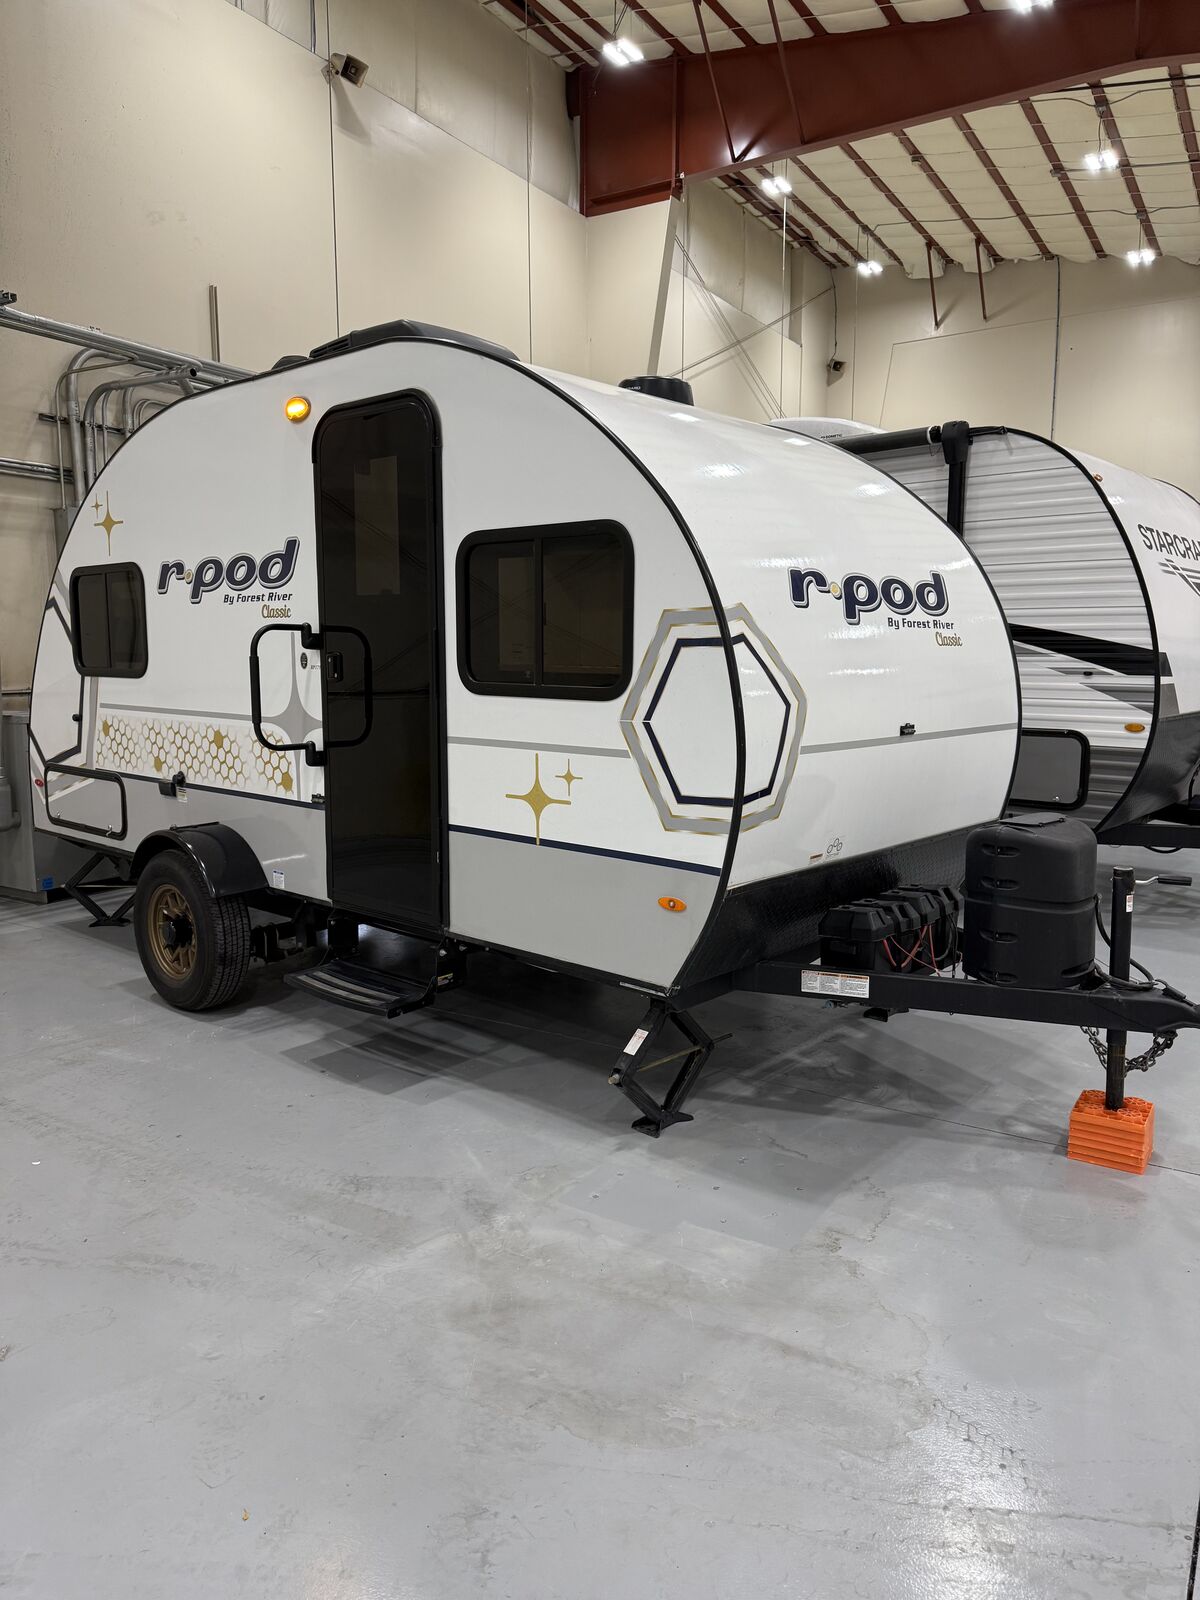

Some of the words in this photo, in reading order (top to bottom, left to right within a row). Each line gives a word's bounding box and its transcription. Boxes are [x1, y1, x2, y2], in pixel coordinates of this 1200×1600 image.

[223, 594, 234, 605] By
[236, 593, 265, 602] Forest
[267, 592, 293, 602] River
[261, 604, 292, 618] Classic
[887, 617, 900, 630] By
[902, 617, 931, 629] Forest
[932, 619, 954, 630] River
[934, 631, 963, 647] Classic
